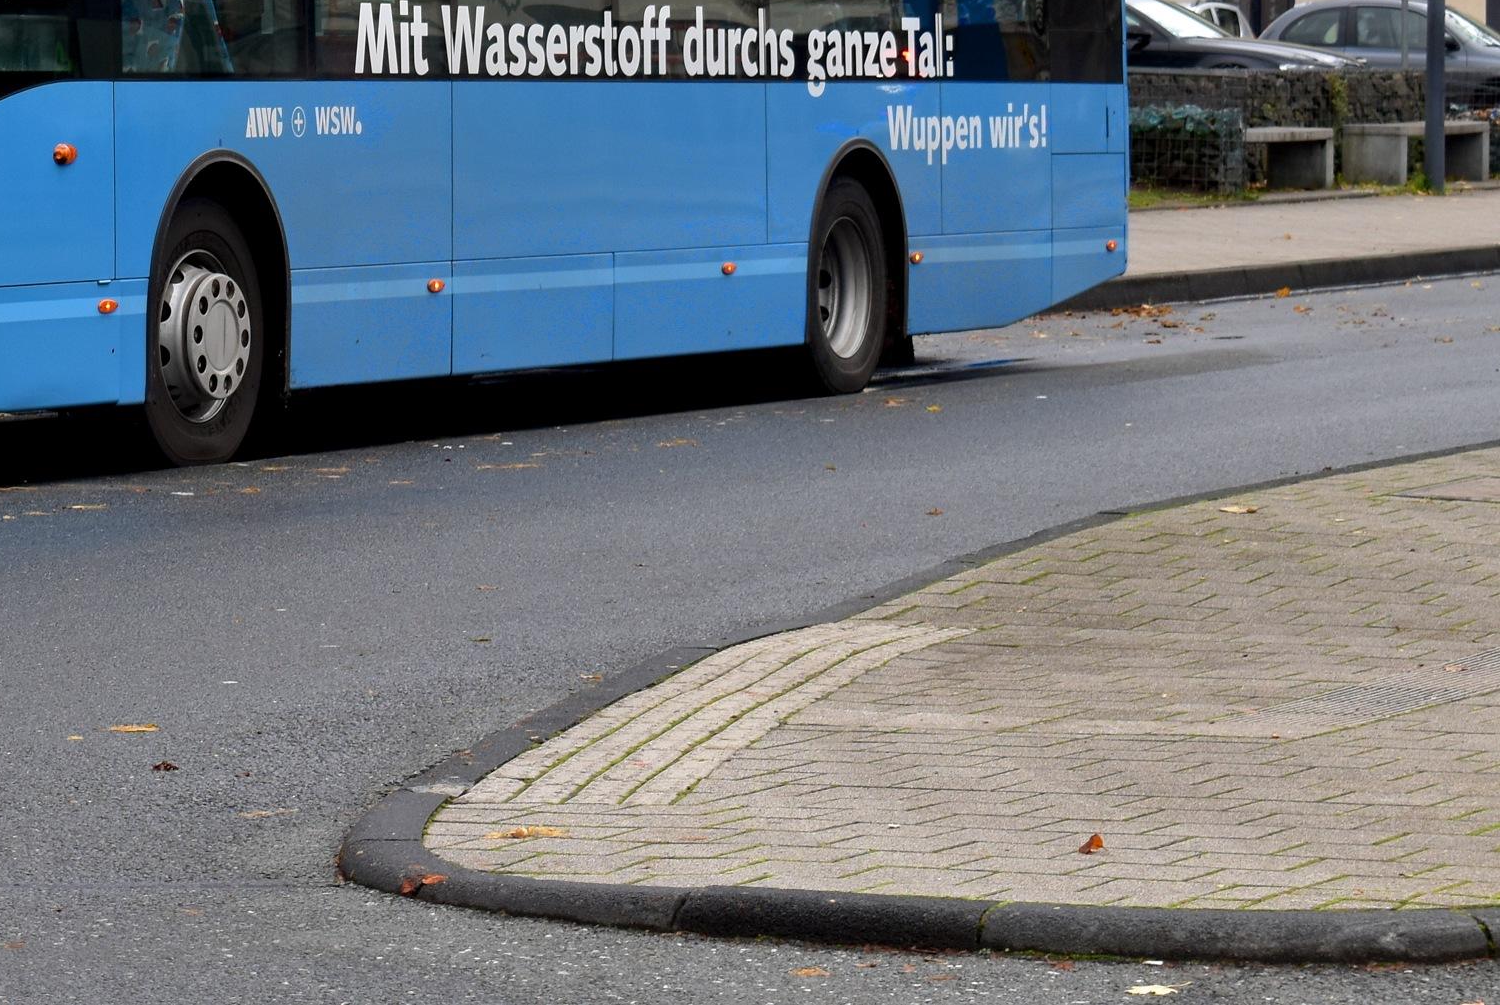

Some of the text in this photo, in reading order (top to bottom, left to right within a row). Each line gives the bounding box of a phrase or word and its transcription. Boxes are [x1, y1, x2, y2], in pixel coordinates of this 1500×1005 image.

[354, 0, 429, 76] Mit
[440, 4, 671, 77] Wasserstoff
[683, 5, 796, 78] durchs
[806, 28, 897, 98] ganze
[245, 107, 283, 138] AWG
[887, 102, 1047, 166] Wuppen wir's!
